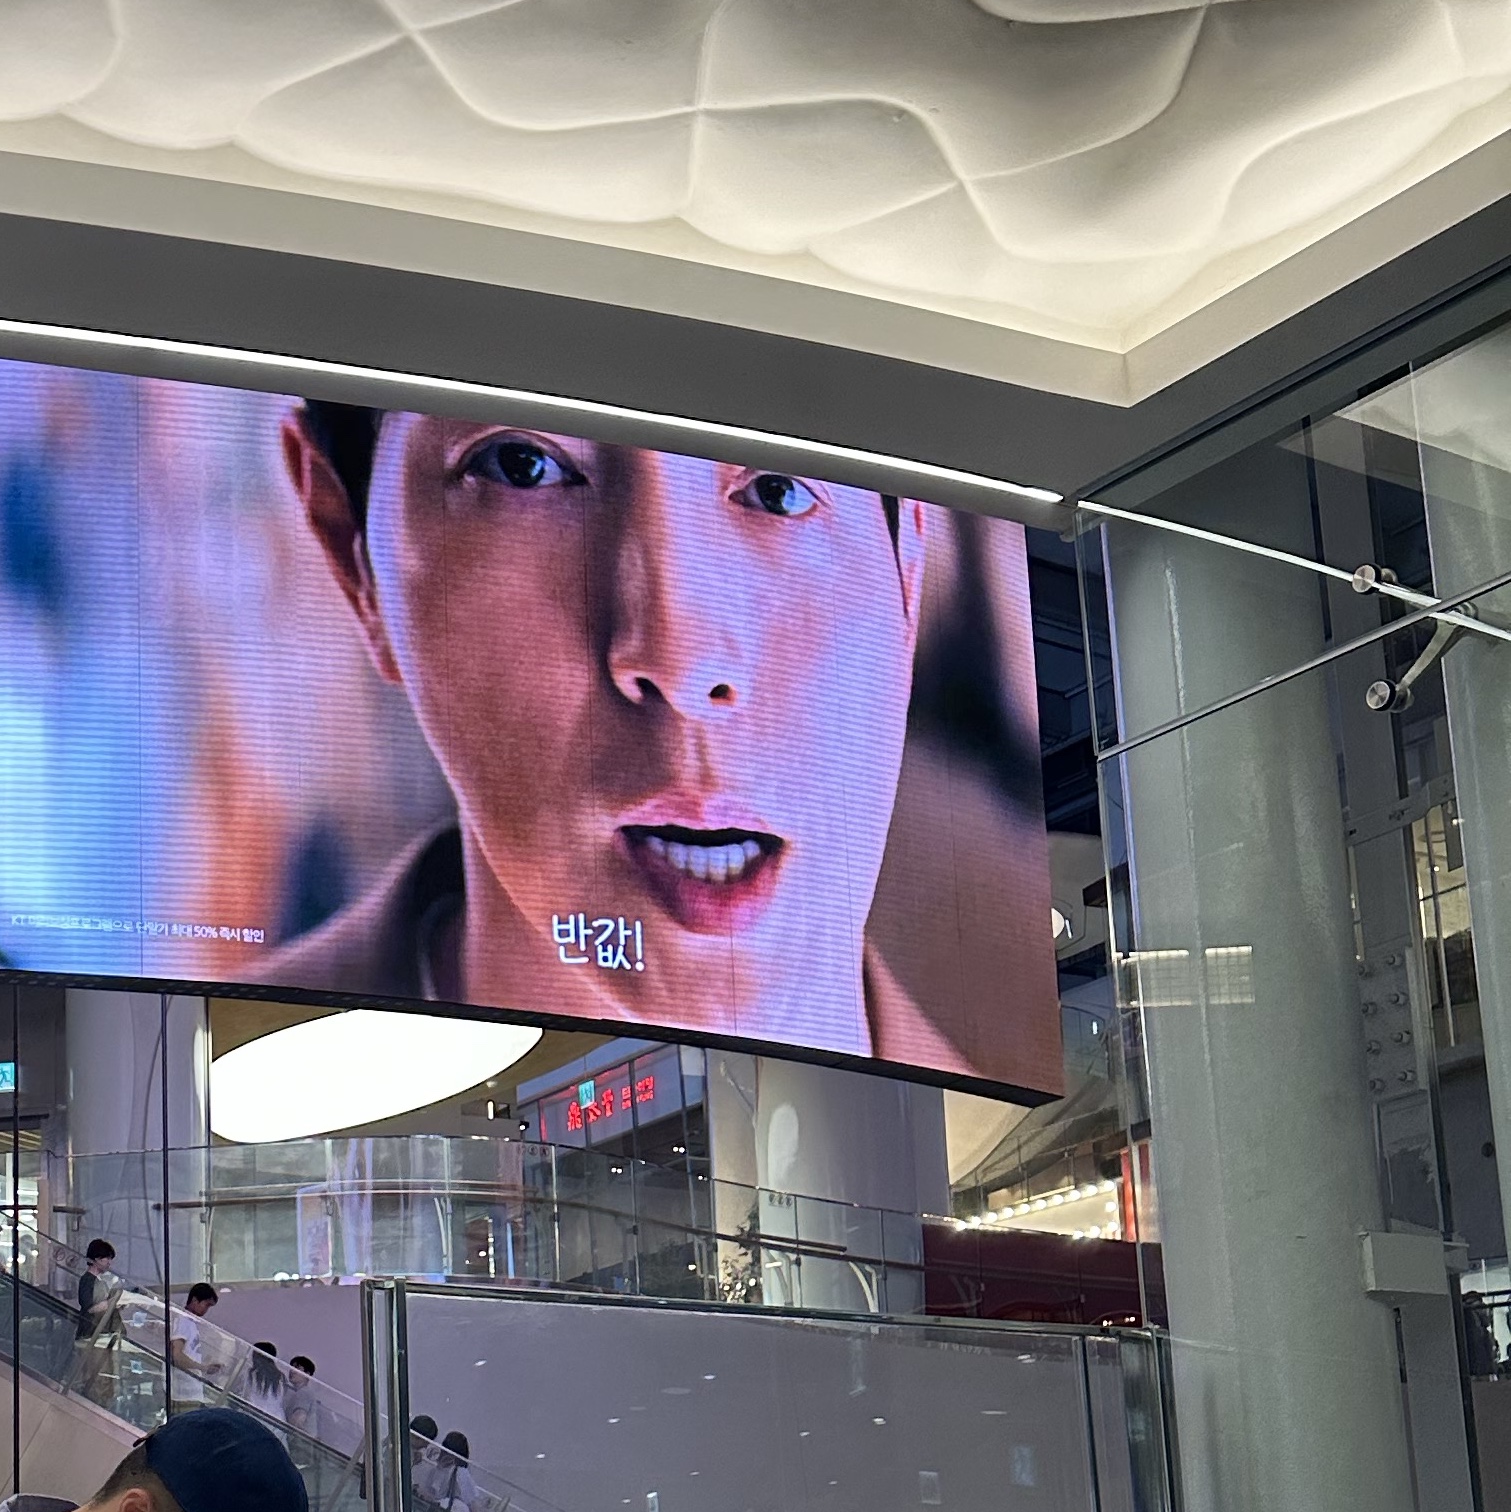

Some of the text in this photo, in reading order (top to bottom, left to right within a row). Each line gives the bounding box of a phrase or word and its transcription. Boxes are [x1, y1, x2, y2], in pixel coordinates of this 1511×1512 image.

[170, 923, 192, 938] 최대
[193, 924, 218, 939] 50%
[219, 926, 241, 942] 즉시
[242, 927, 265, 943] 할인
[552, 912, 645, 972] 반값!
